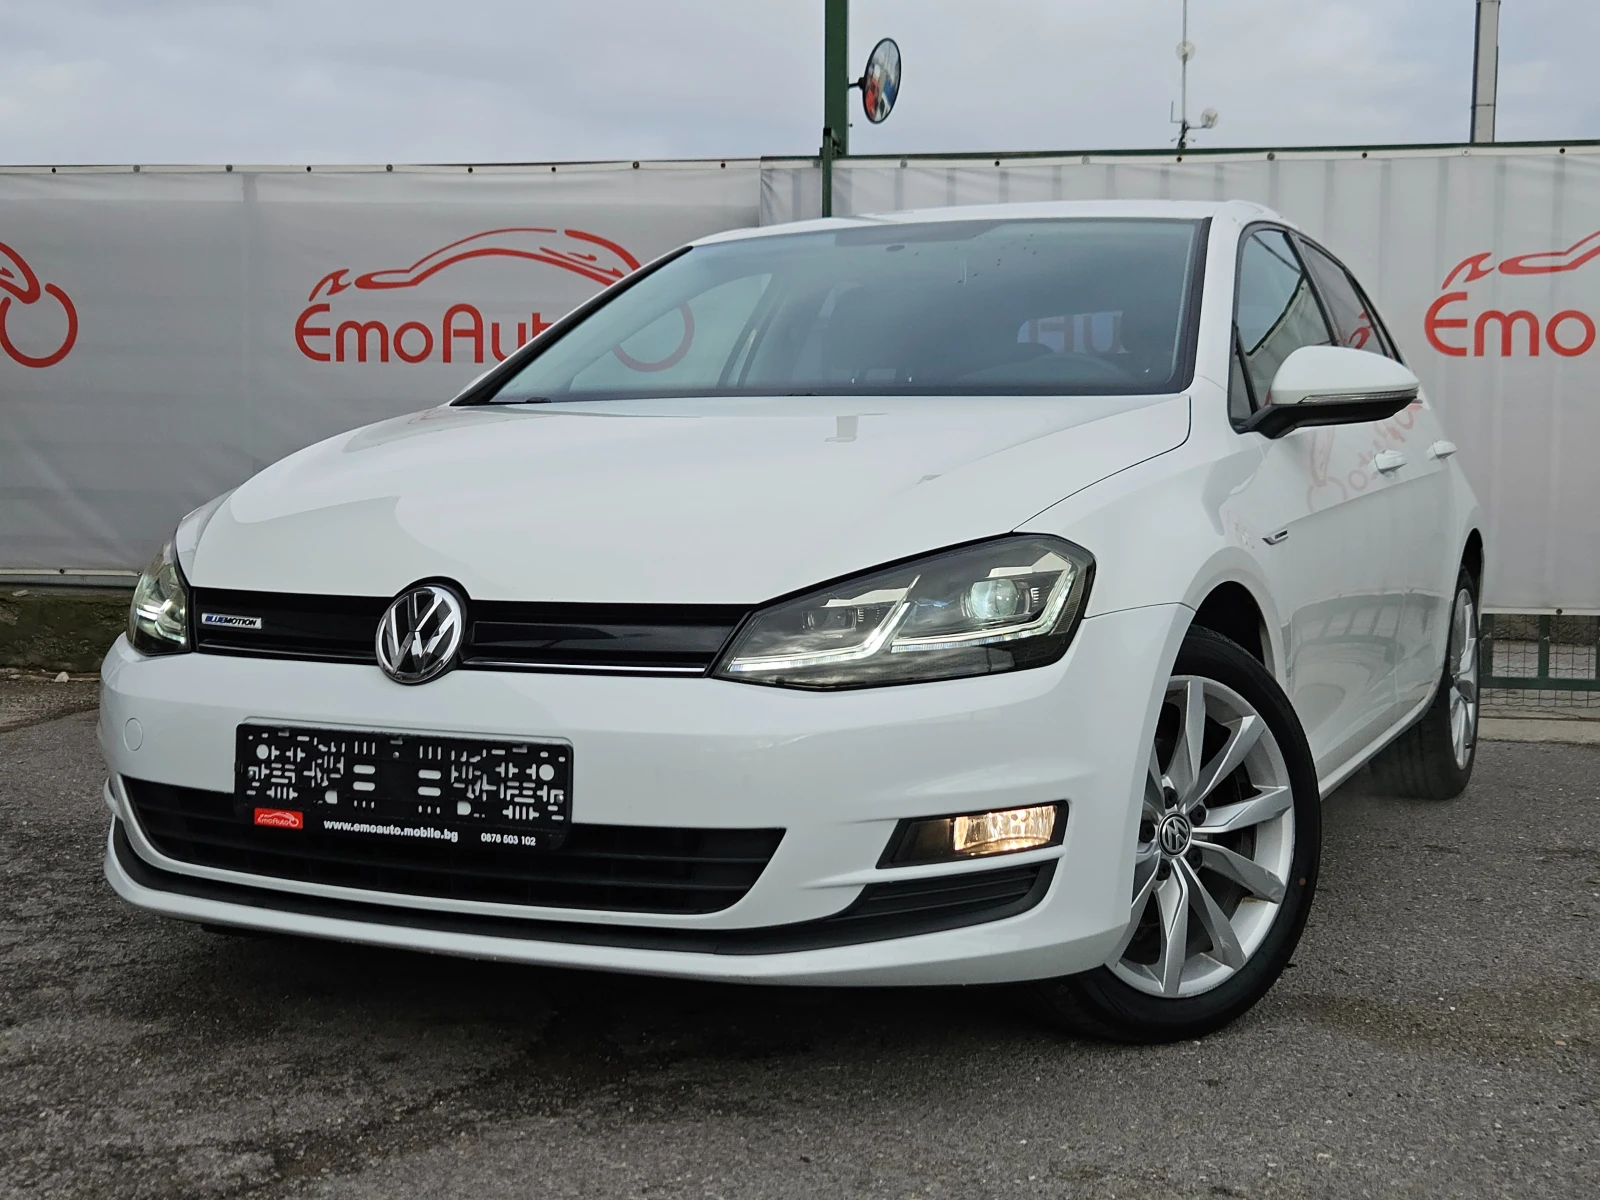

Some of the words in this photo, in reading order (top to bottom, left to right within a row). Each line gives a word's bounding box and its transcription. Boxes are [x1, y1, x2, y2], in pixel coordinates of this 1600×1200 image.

[204, 615, 257, 627] BLUEMOTION
[323, 820, 458, 842] www.emoauto.mobile.bg
[503, 834, 519, 844] 503
[521, 836, 536, 846] 102
